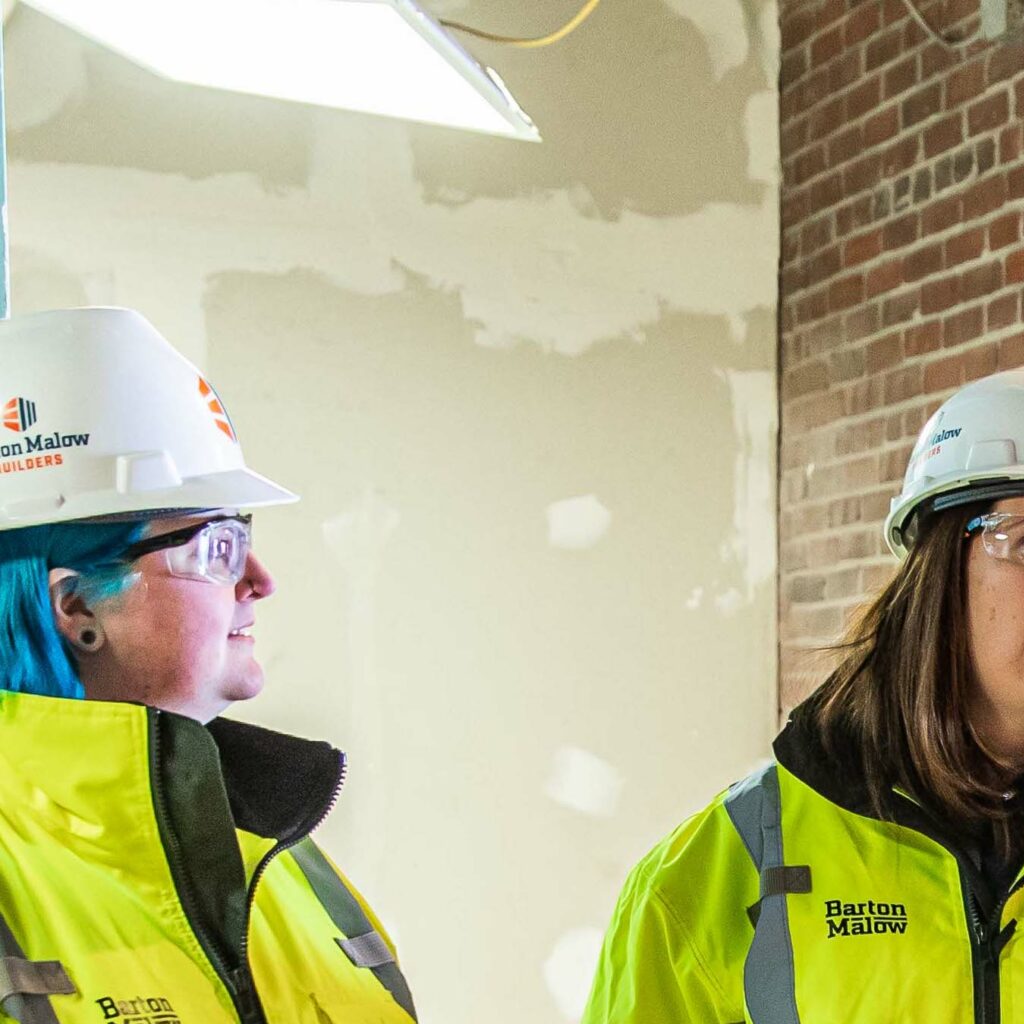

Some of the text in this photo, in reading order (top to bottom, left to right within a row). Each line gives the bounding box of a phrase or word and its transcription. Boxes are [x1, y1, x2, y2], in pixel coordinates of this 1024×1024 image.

[0, 432, 90, 457] on Malow
[0, 453, 63, 473] UILDERS
[824, 899, 906, 918] Barton
[826, 917, 907, 939] Malow
[95, 996, 175, 1019] Barton
